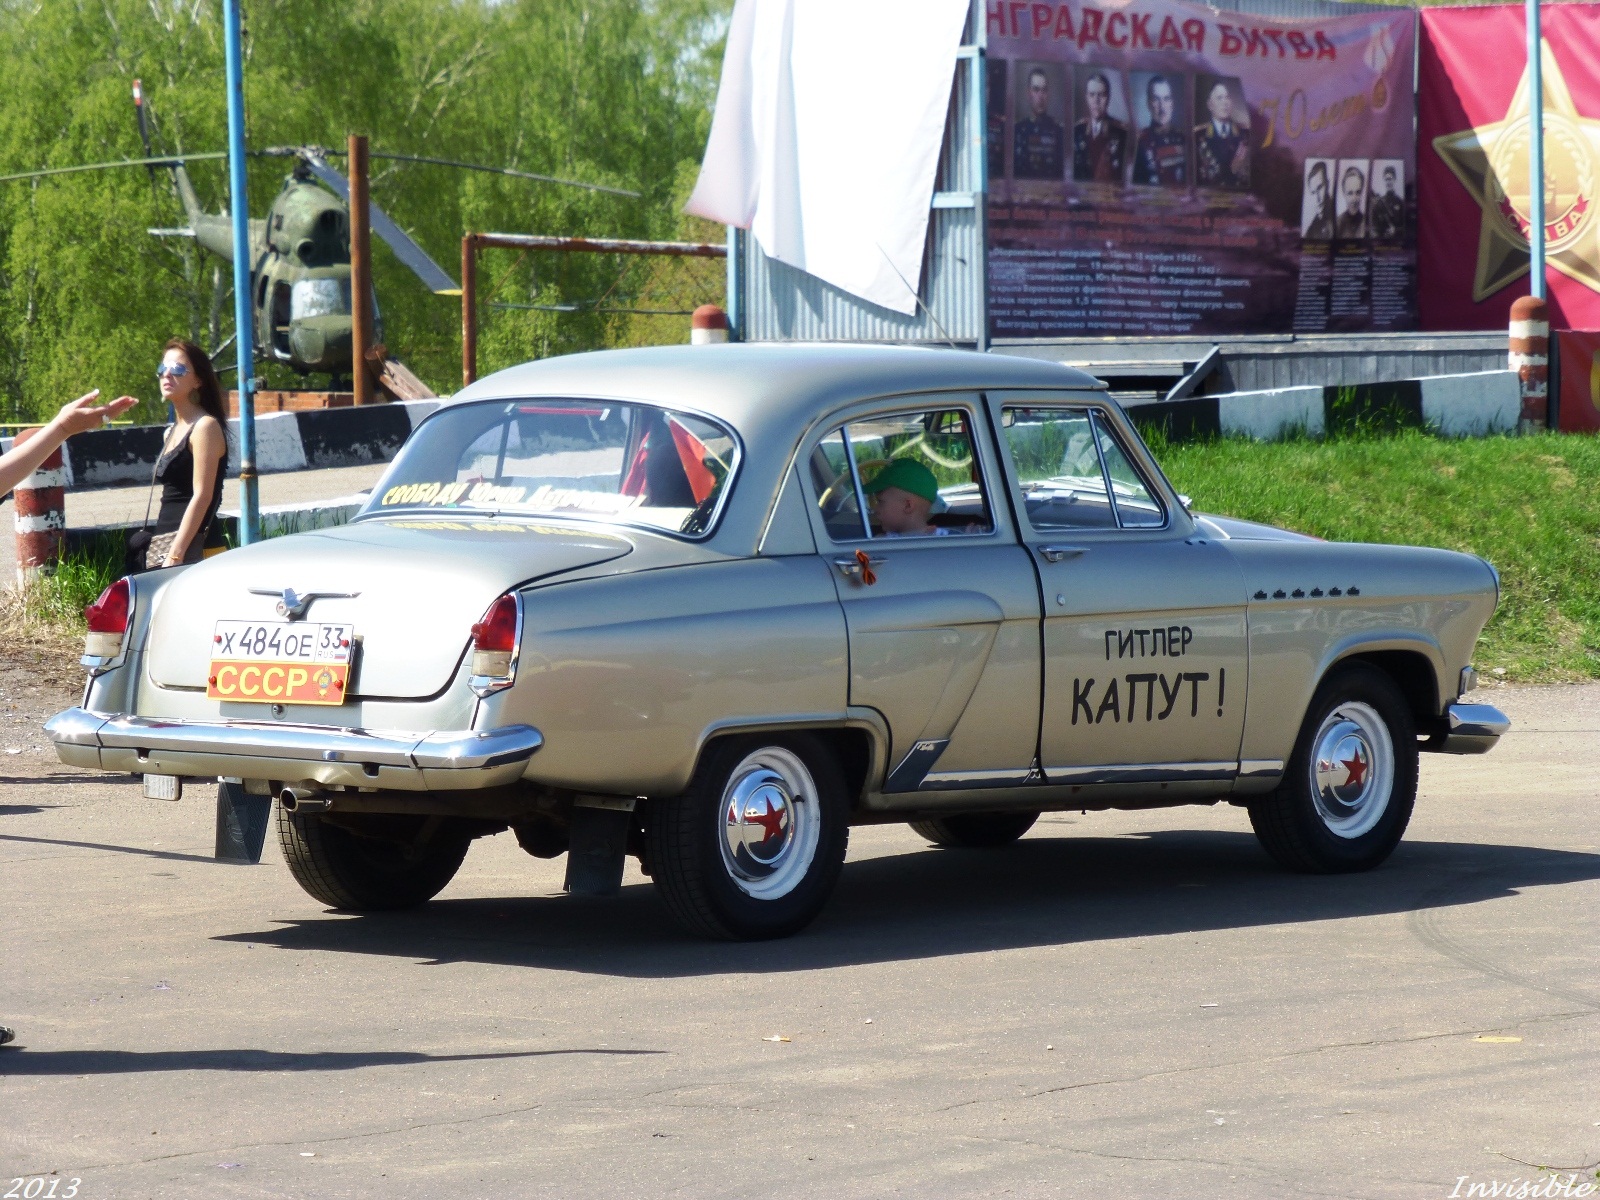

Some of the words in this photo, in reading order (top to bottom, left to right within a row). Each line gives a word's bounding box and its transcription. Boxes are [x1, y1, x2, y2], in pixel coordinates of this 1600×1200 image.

[1217, 23, 1337, 61] БИТВА
[1259, 88, 1308, 149] 70
[1506, 210, 1584, 242] СВА
[320, 627, 344, 649] 33
[1104, 625, 1193, 661] ГИТЛЕР
[317, 650, 334, 659] RUS
[216, 665, 308, 697] СССР
